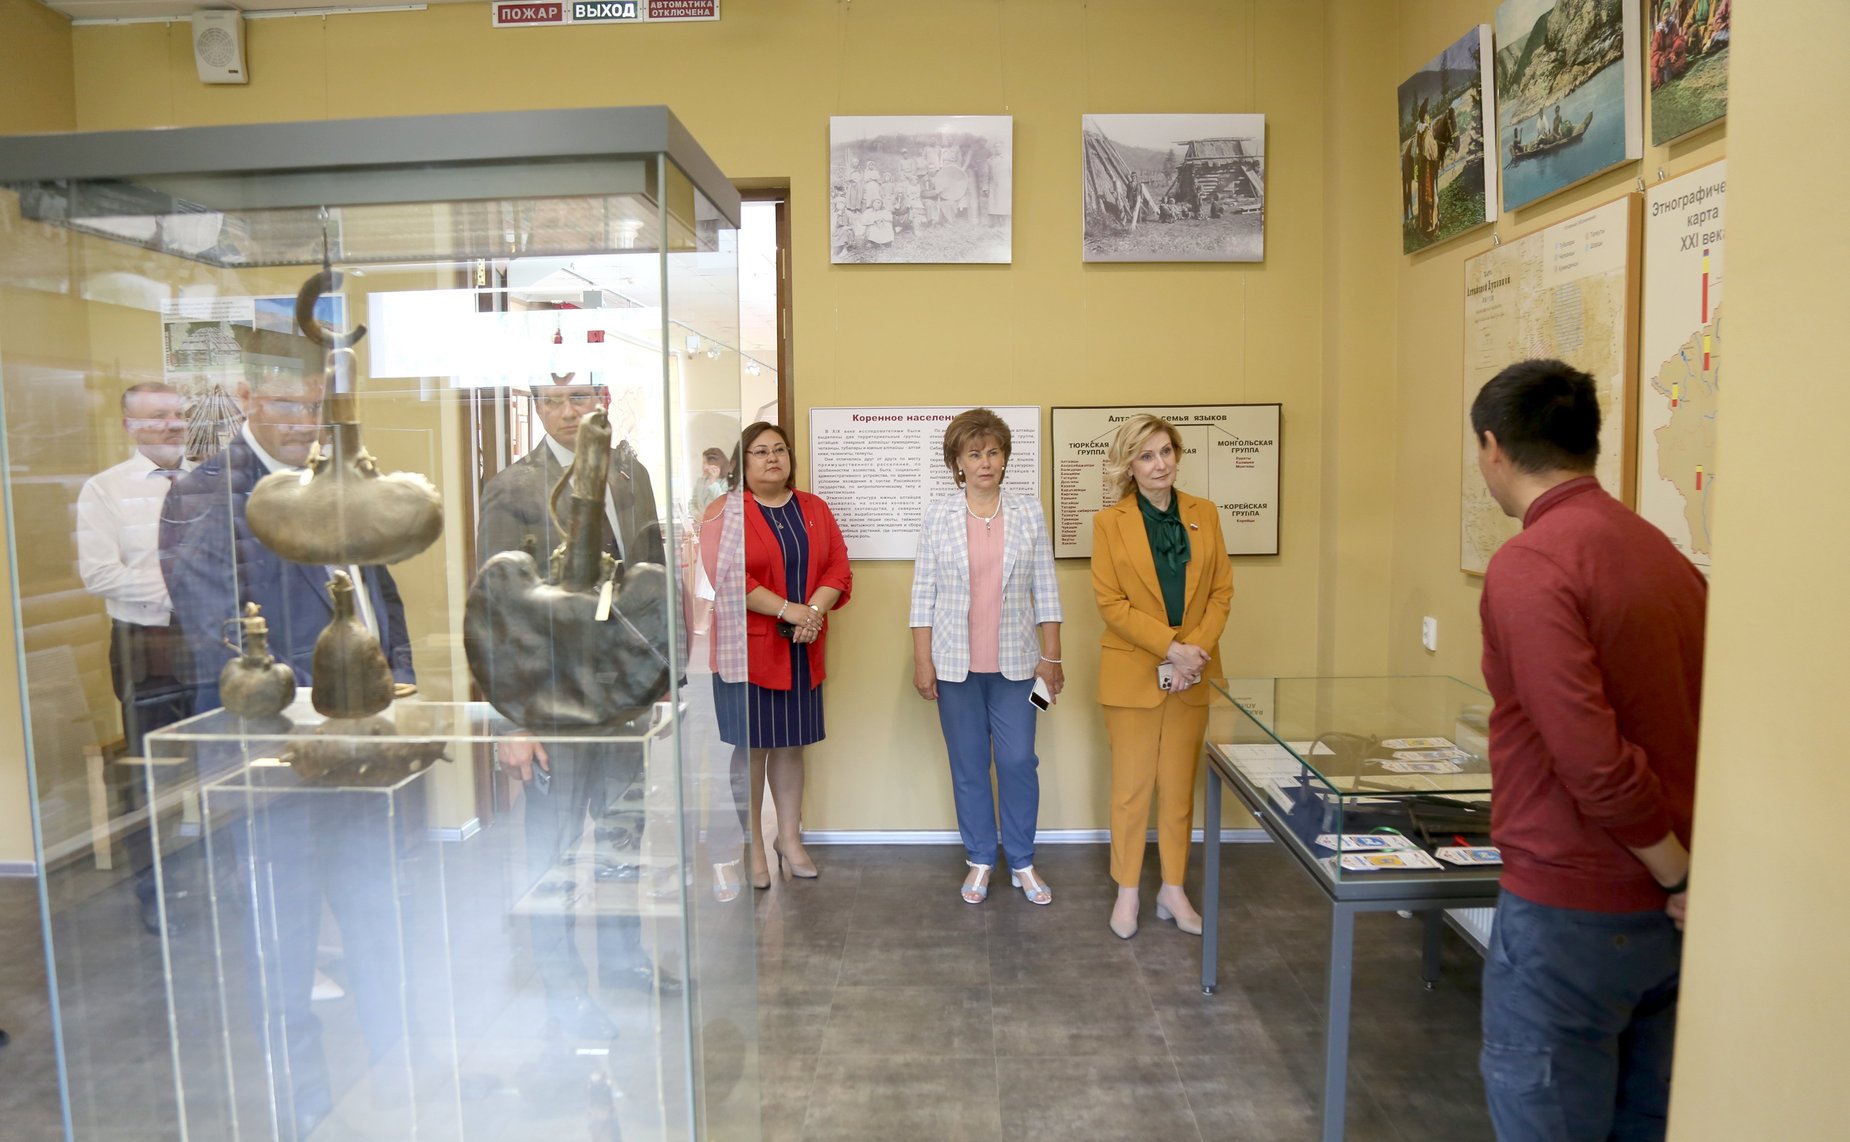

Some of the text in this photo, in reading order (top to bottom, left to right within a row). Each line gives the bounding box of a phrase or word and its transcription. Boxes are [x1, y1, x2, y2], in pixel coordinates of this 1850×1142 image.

[575, 2, 636, 18] ВЫХОД
[650, 0, 712, 8] АВТОМАТИКА
[501, 7, 558, 20] ПОЖАР
[652, 8, 710, 16] ОТКЛЮЧЕНА
[1652, 181, 1726, 217] Этнографиче
[1687, 206, 1719, 227] карта
[852, 414, 904, 422] Коренное
